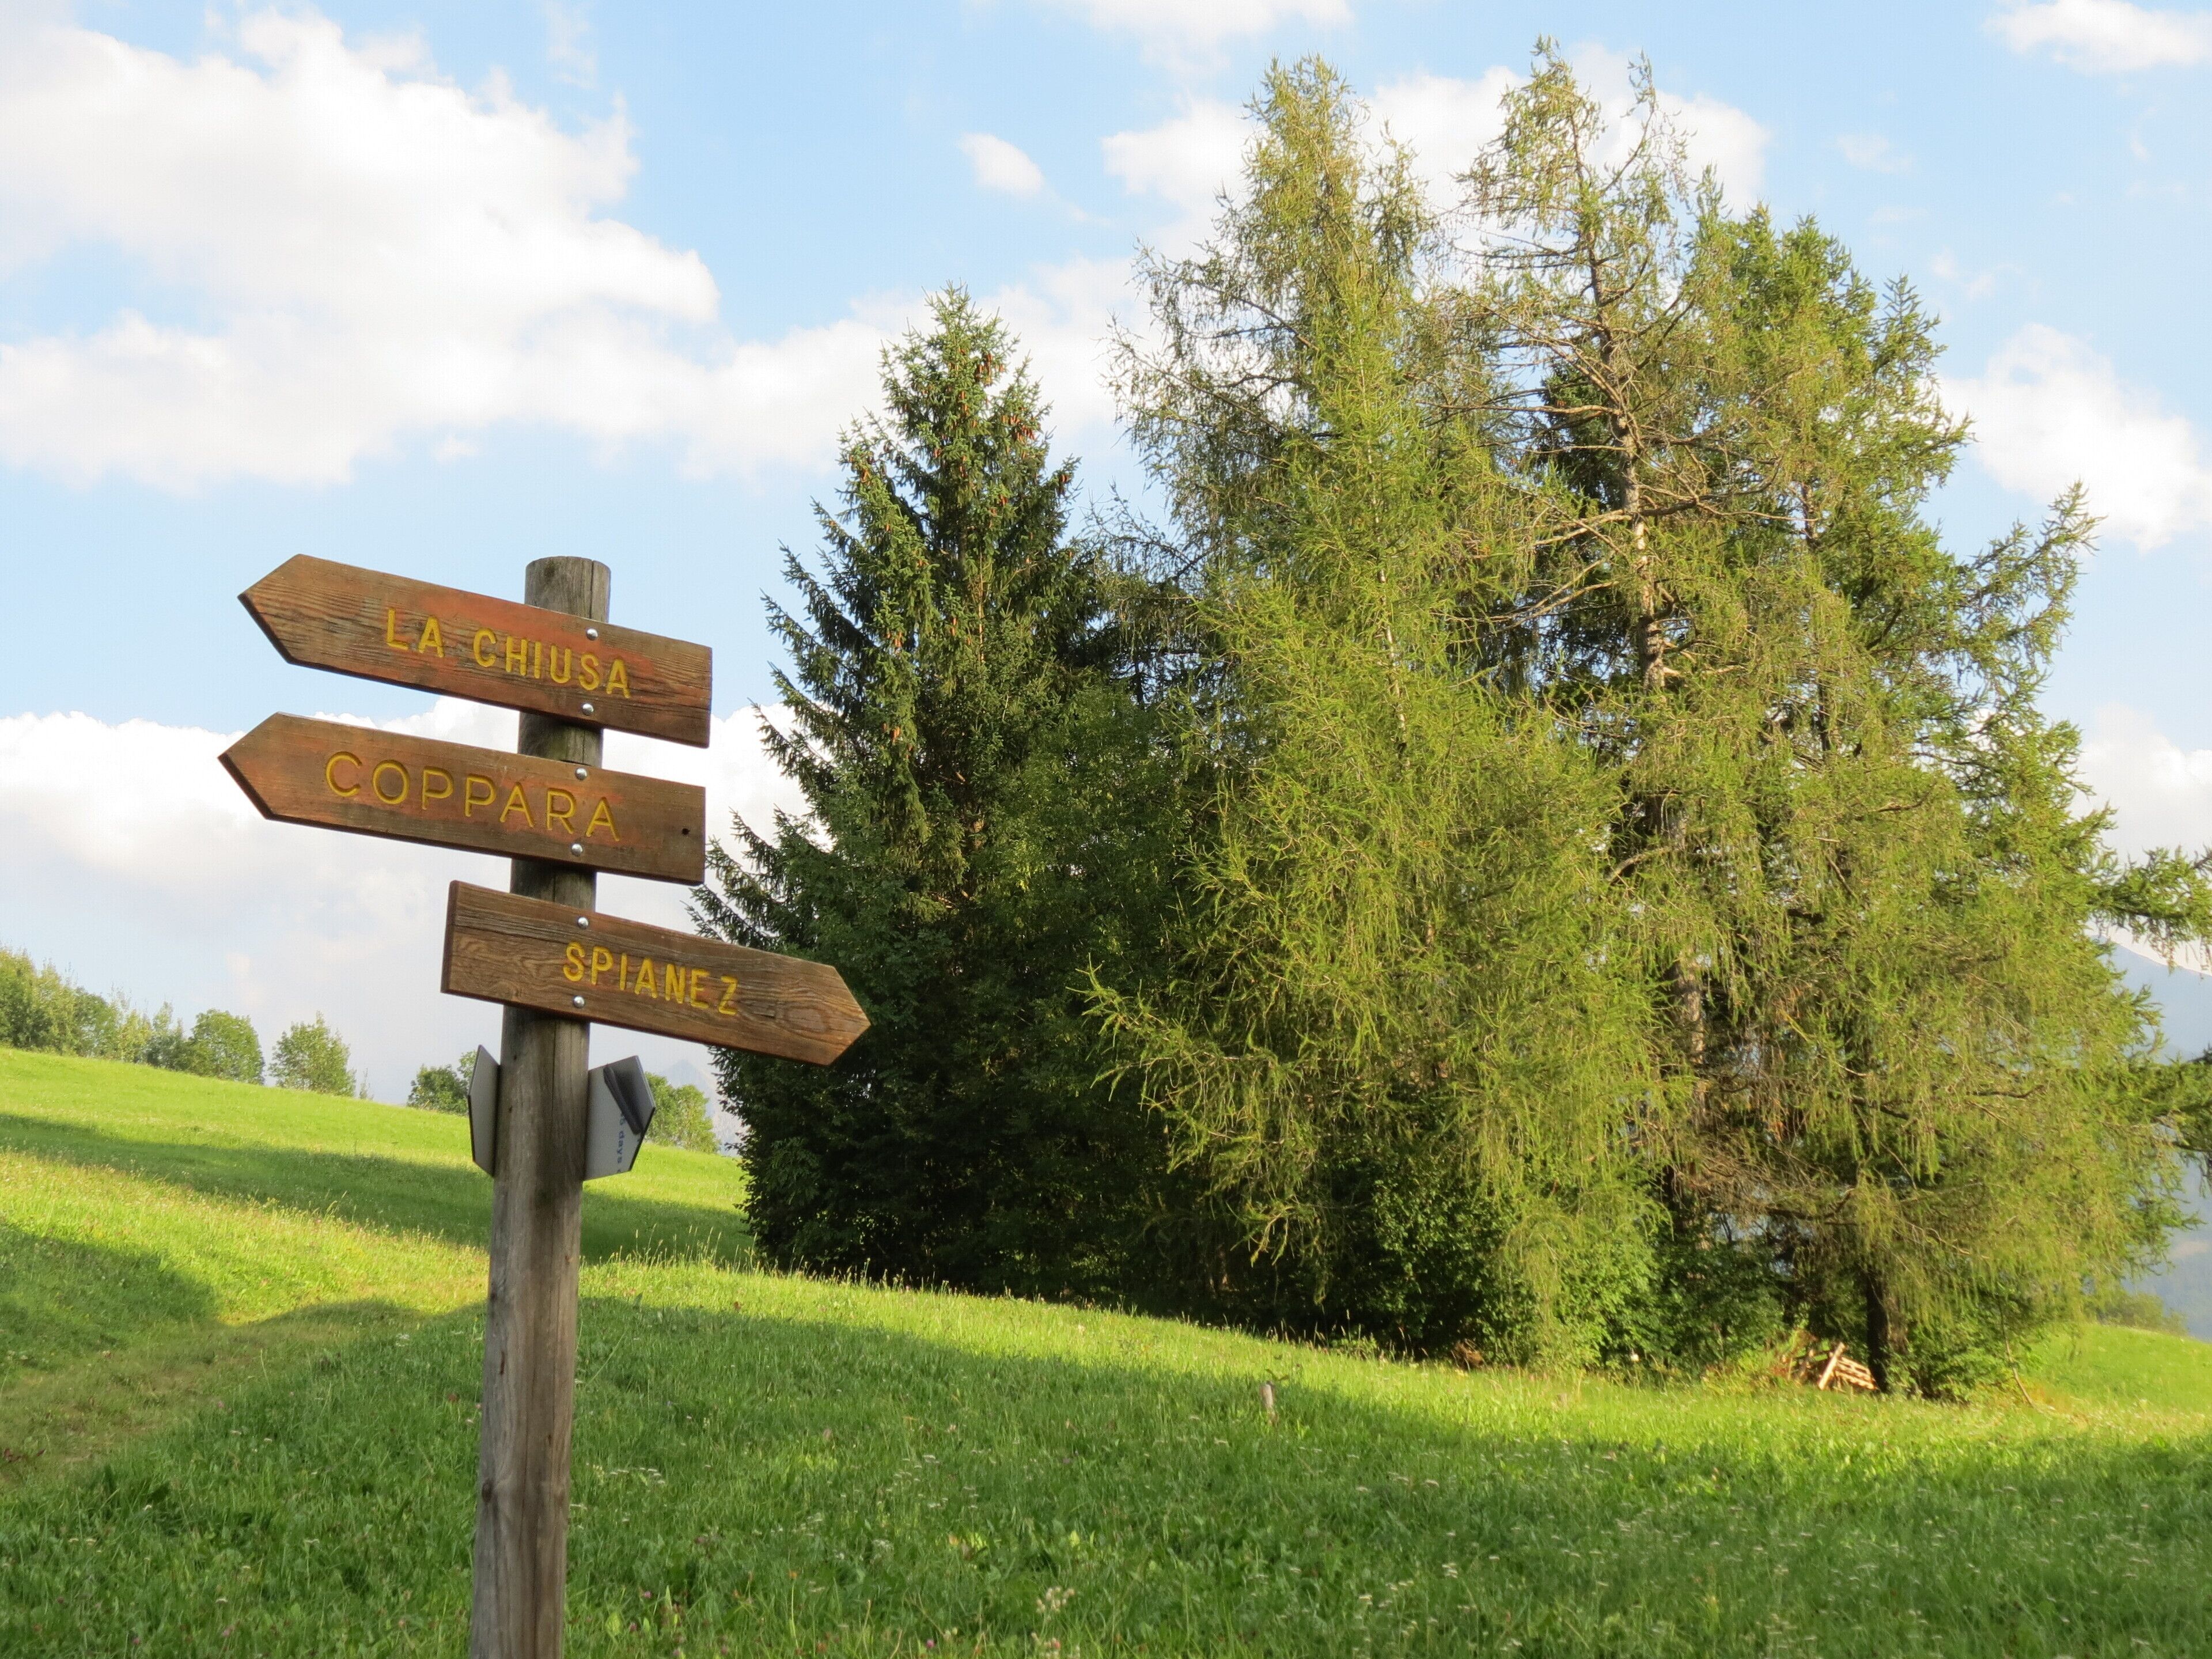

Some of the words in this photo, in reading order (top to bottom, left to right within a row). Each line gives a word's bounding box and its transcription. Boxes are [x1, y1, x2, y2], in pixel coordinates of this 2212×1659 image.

[385, 608, 445, 657] LA
[472, 628, 631, 699] CHIUSA
[325, 752, 620, 842] COPPARA
[562, 942, 738, 1016] SPIANEZ
